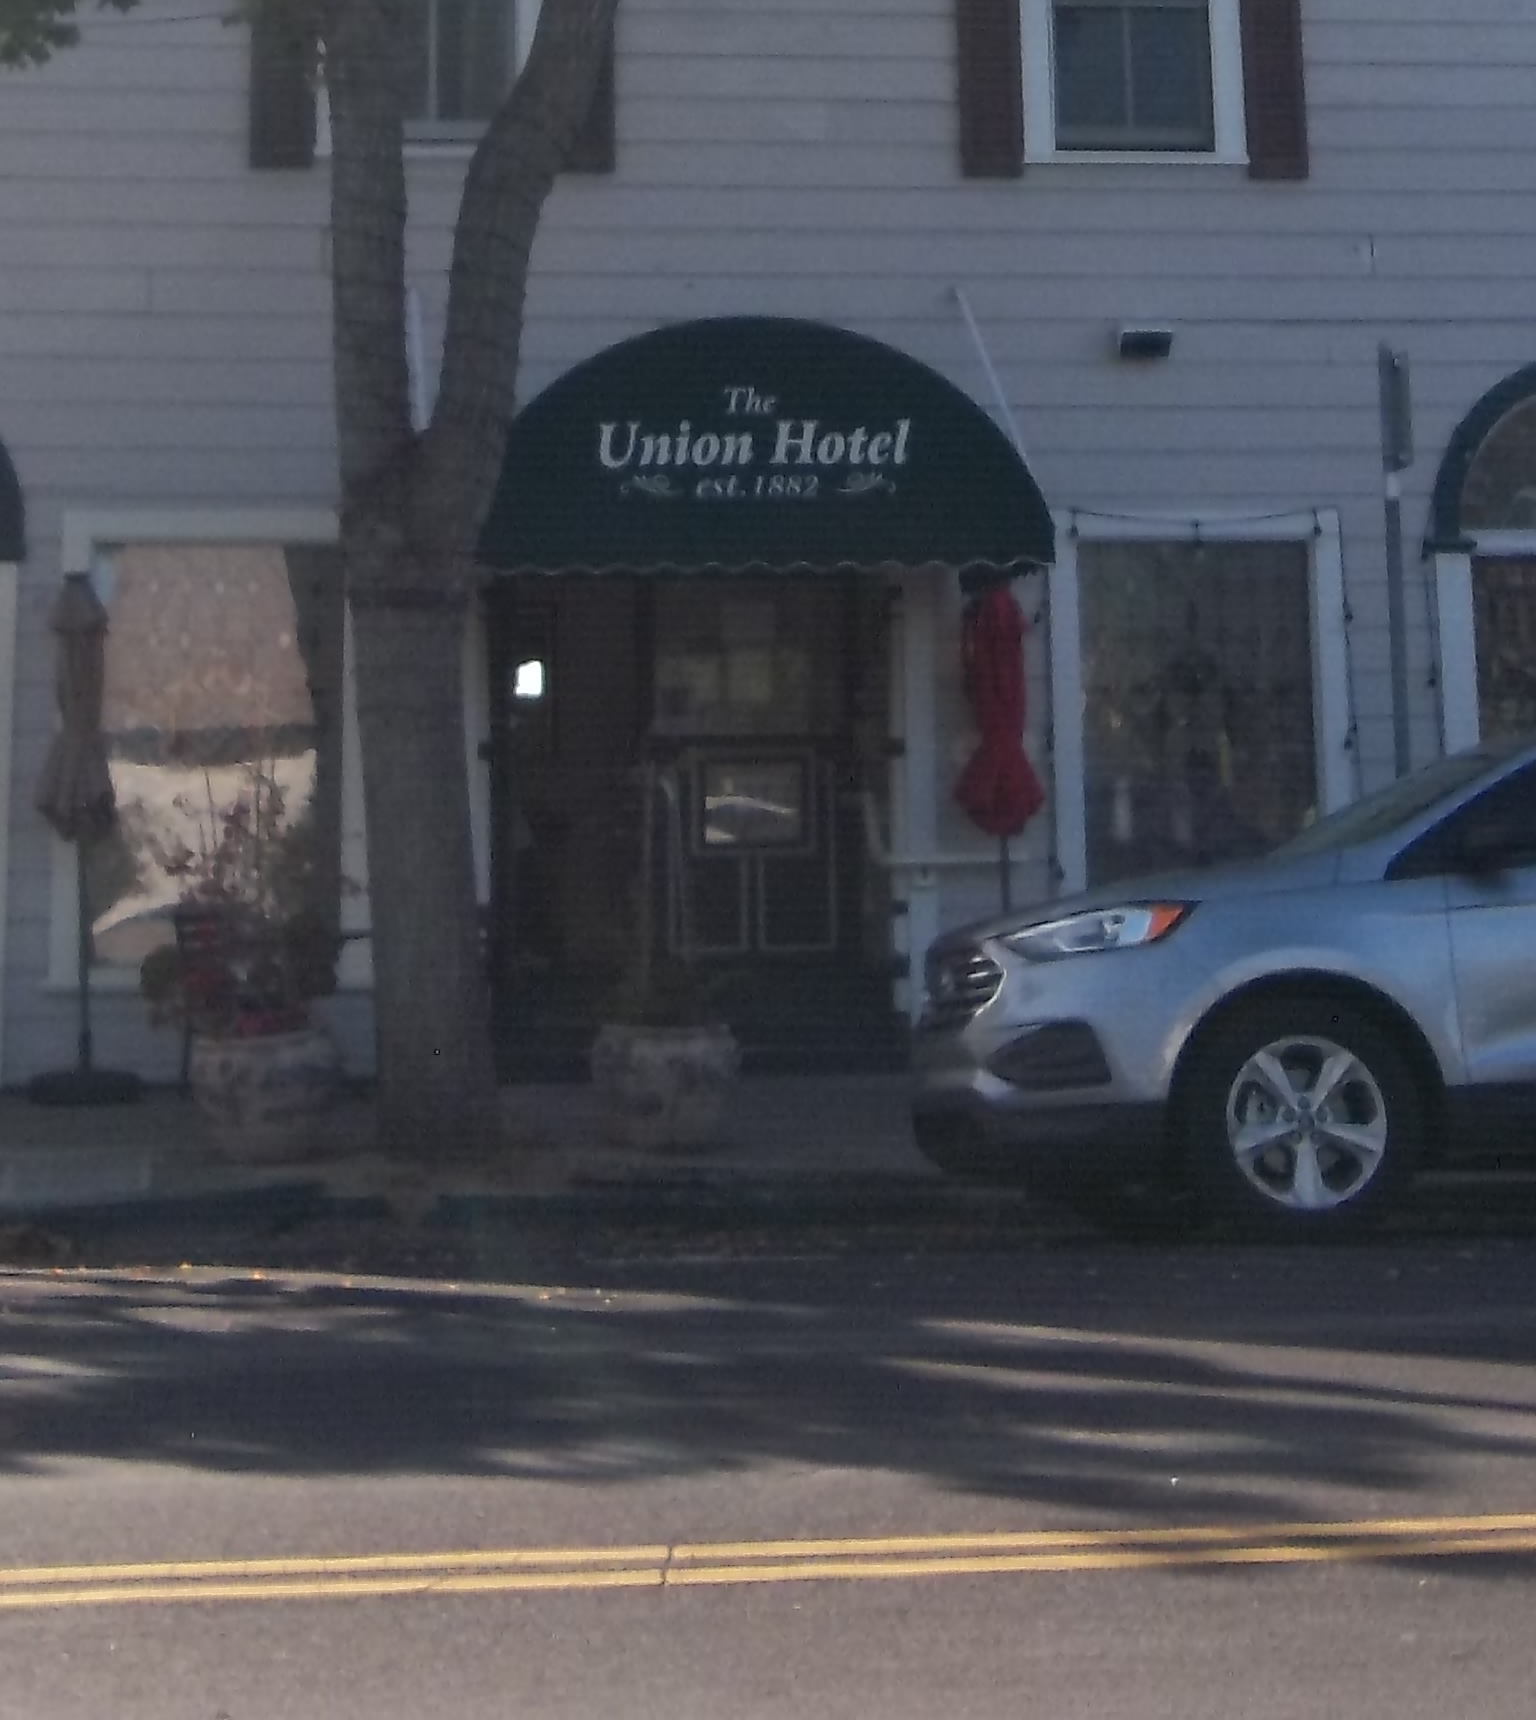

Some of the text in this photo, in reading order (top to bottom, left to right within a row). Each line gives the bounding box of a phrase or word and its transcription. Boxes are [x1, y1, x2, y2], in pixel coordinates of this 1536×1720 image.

[723, 385, 777, 415] The
[597, 417, 912, 469] Union Hotel
